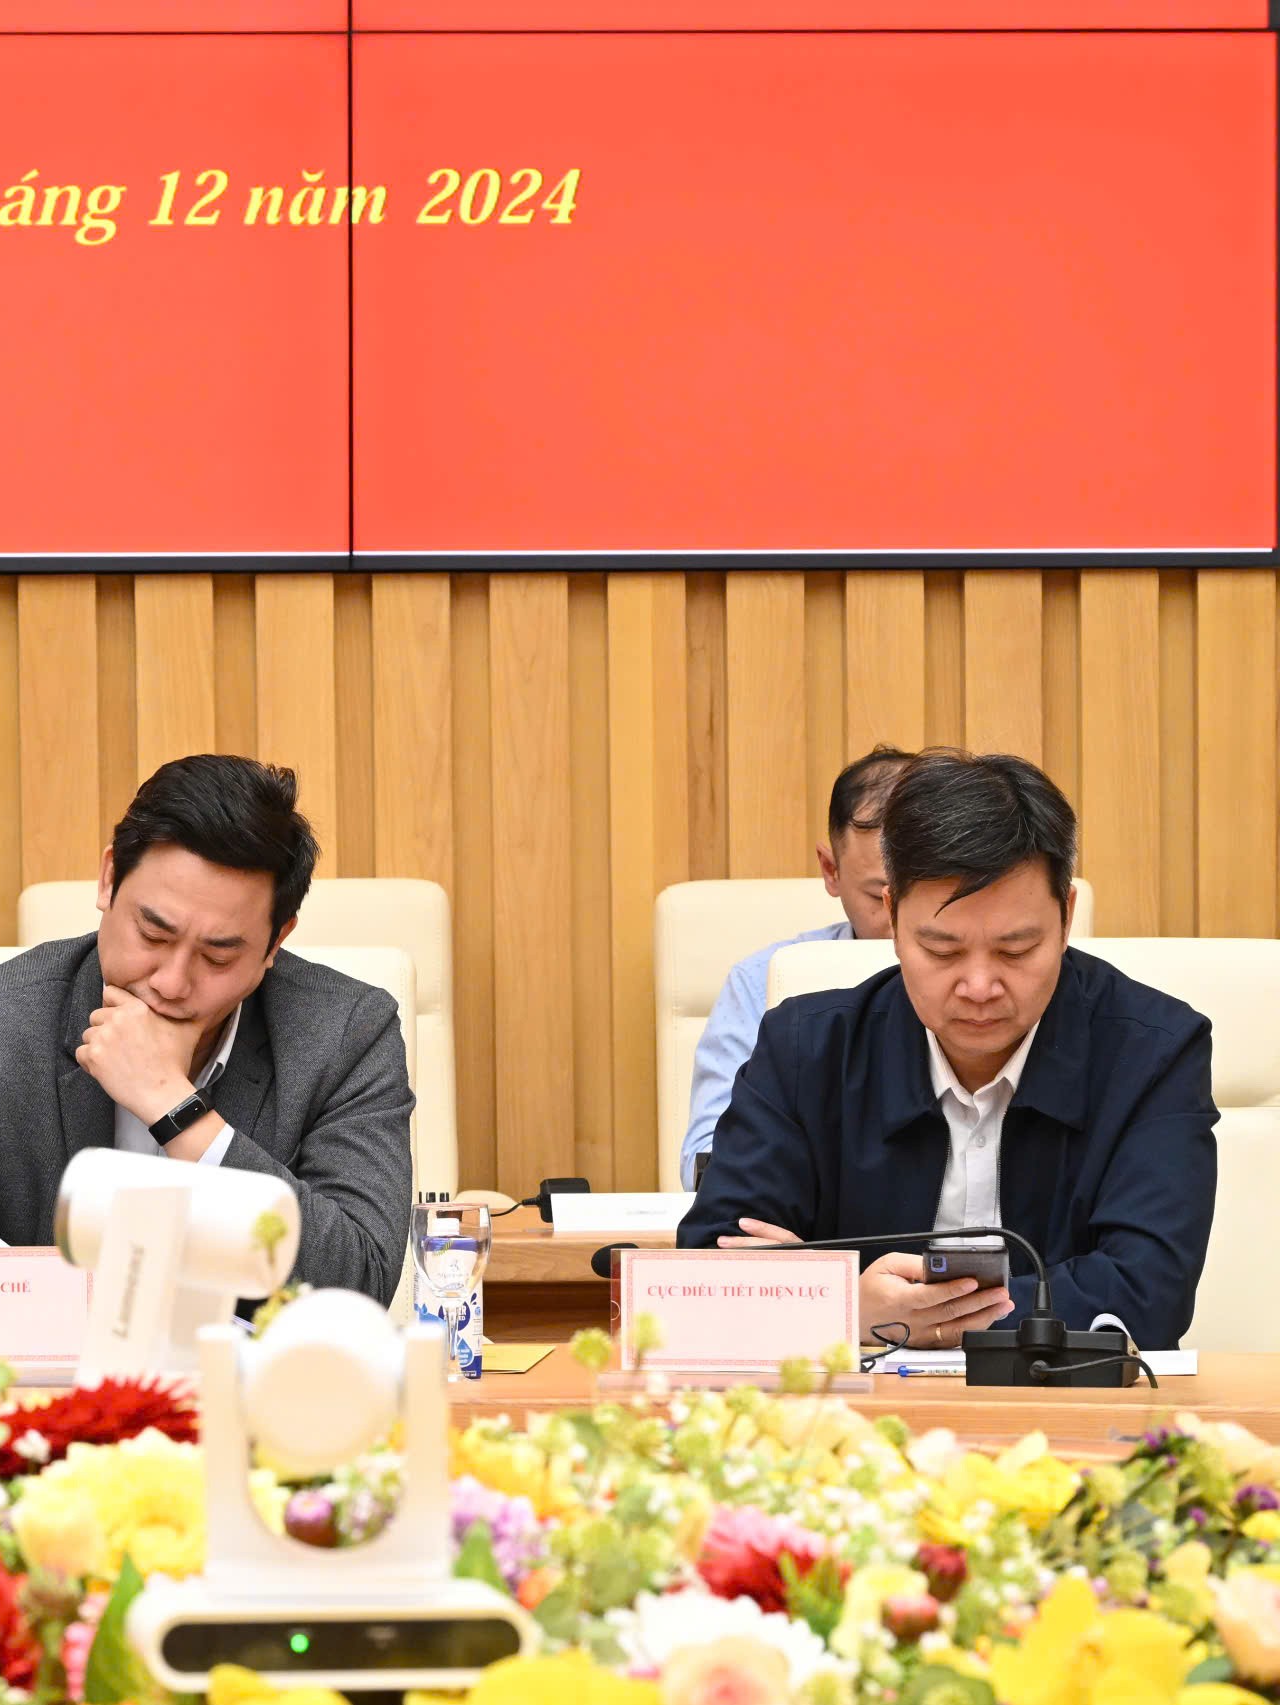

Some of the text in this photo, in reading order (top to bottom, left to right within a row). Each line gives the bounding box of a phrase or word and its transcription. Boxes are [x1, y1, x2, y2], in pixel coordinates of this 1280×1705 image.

[148, 169, 229, 226] 12
[243, 170, 387, 226] năm
[415, 168, 581, 226] 2024
[0, 1279, 31, 1294] CHẾ
[647, 1285, 678, 1300] CỤC
[720, 1282, 755, 1297] TIẾT
[798, 1284, 830, 1300] LỰC
